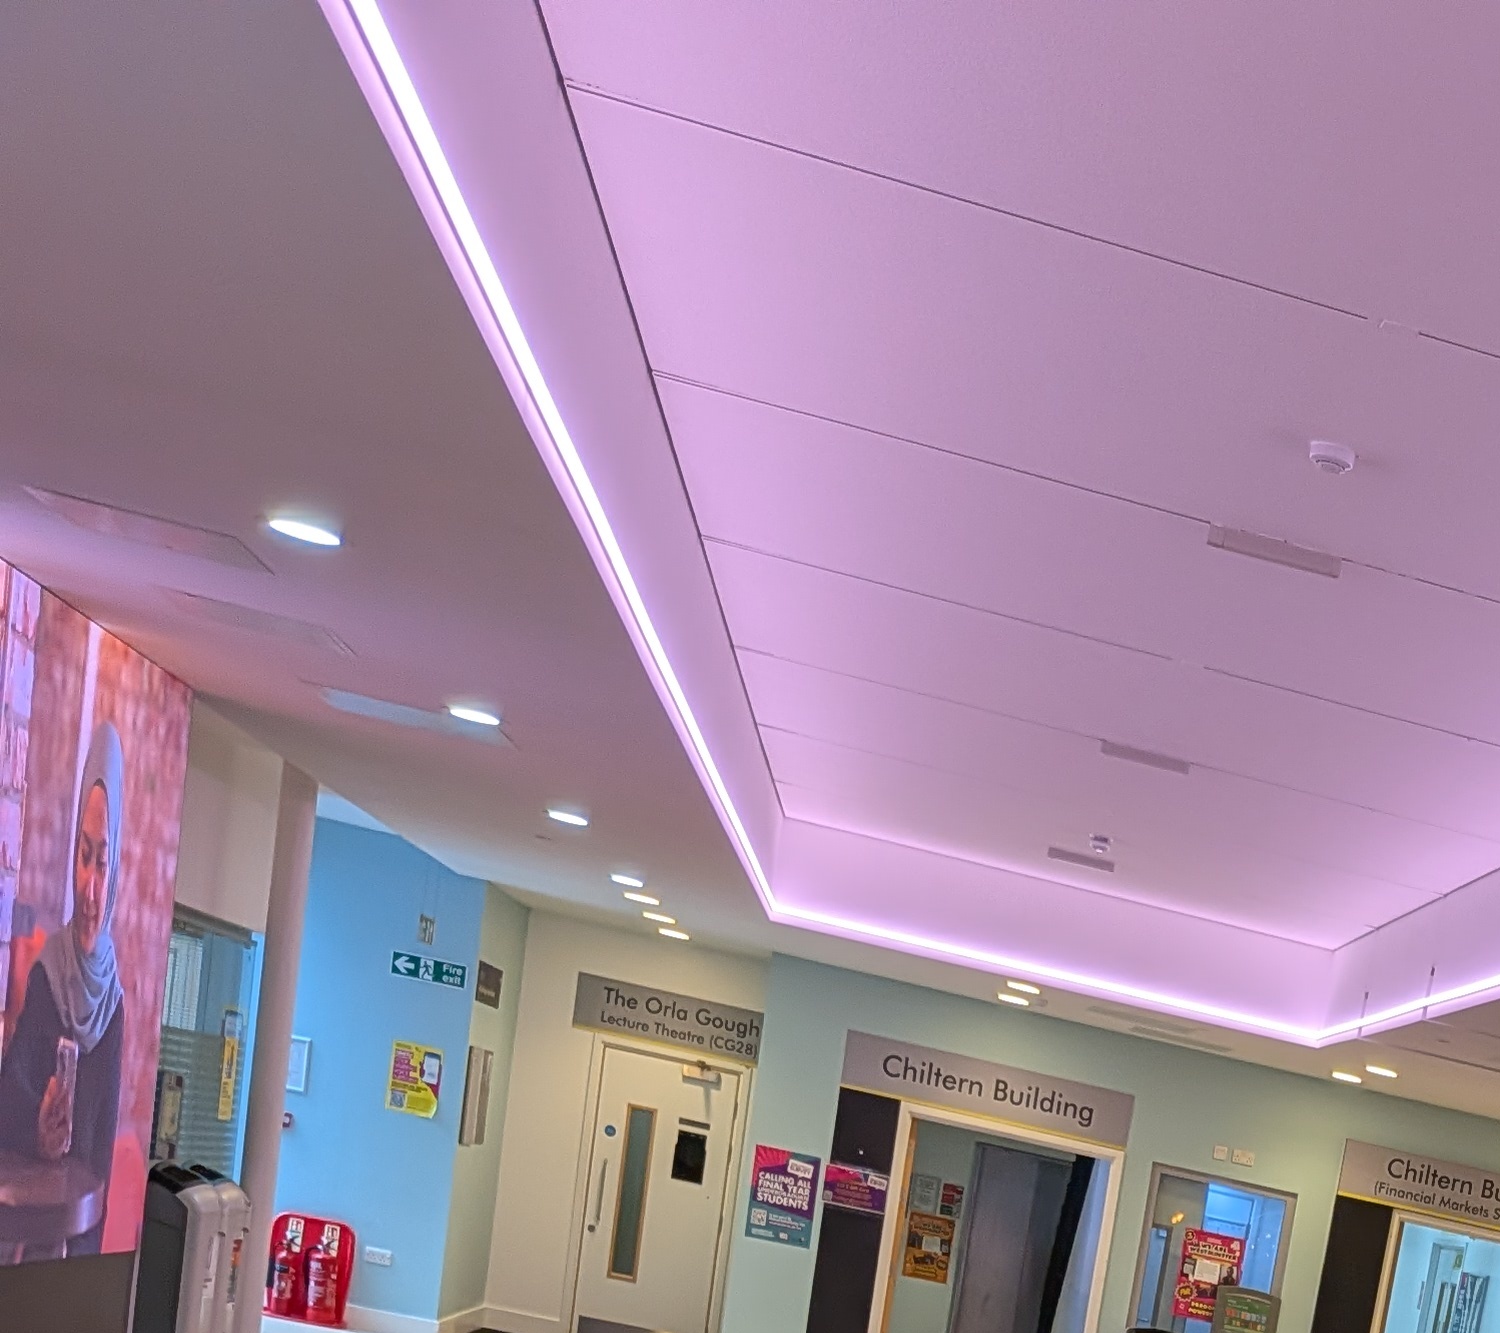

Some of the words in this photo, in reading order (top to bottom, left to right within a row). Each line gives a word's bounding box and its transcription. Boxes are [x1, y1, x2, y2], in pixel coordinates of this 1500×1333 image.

[442, 963, 463, 976] Fire
[442, 975, 461, 986] exit
[603, 986, 638, 1009] The
[645, 996, 688, 1021] Orla
[695, 1008, 760, 1038] Gough
[600, 1011, 649, 1032] Lecture
[655, 1022, 704, 1045] Theatre
[710, 1035, 758, 1058] (CG28)
[882, 1054, 983, 1097] Chiltern
[993, 1079, 1095, 1127] Building
[758, 1171, 795, 1186] CALLING
[797, 1179, 811, 1189] ALL
[758, 1179, 784, 1193] FINAL
[787, 1184, 810, 1195] YEAR
[1387, 1158, 1473, 1195] Chiltern
[756, 1192, 809, 1211] STUDENTS
[1374, 1180, 1436, 1205] (Financial
[1439, 1196, 1489, 1218] Markets
